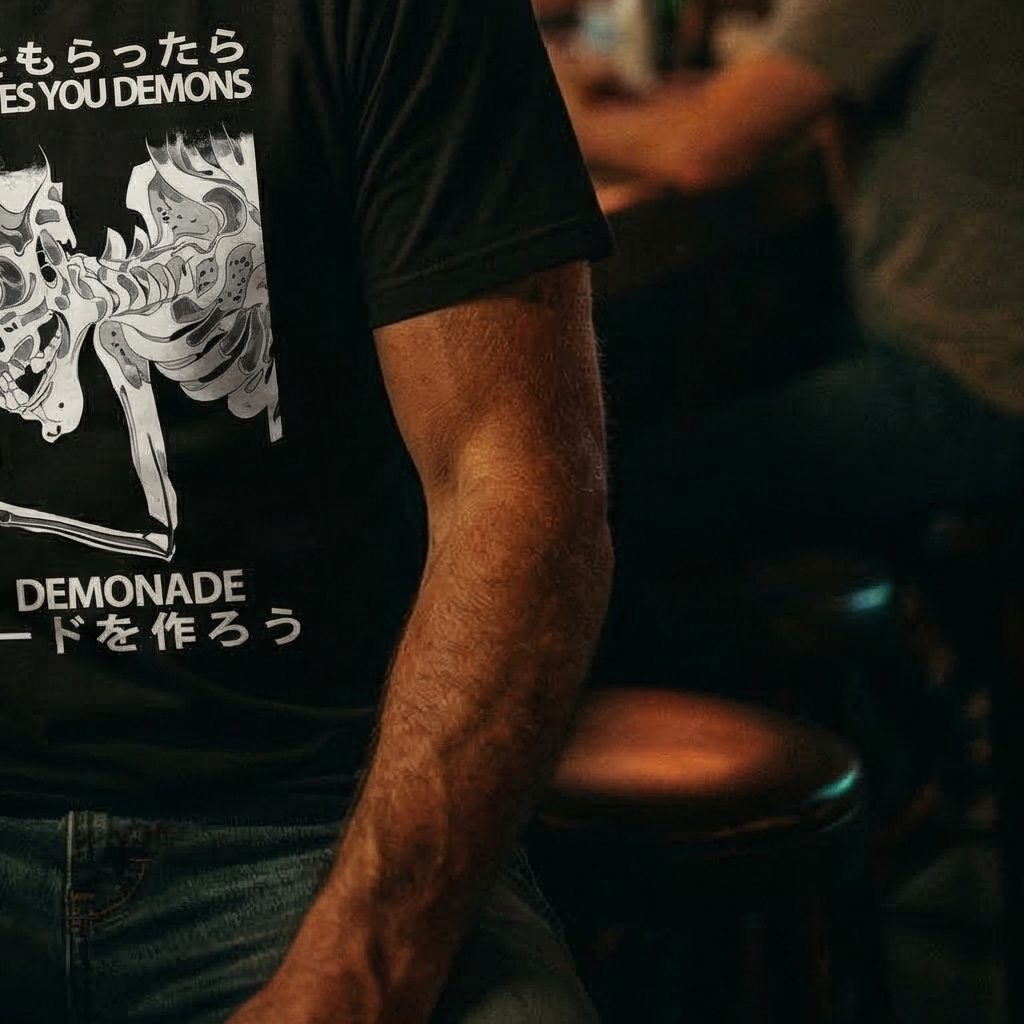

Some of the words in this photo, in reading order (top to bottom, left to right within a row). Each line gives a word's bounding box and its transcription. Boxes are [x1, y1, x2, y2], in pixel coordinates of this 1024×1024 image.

[38, 78, 107, 111] YOU
[113, 69, 253, 107] DEMONS
[16, 570, 246, 612] DEMONADE
